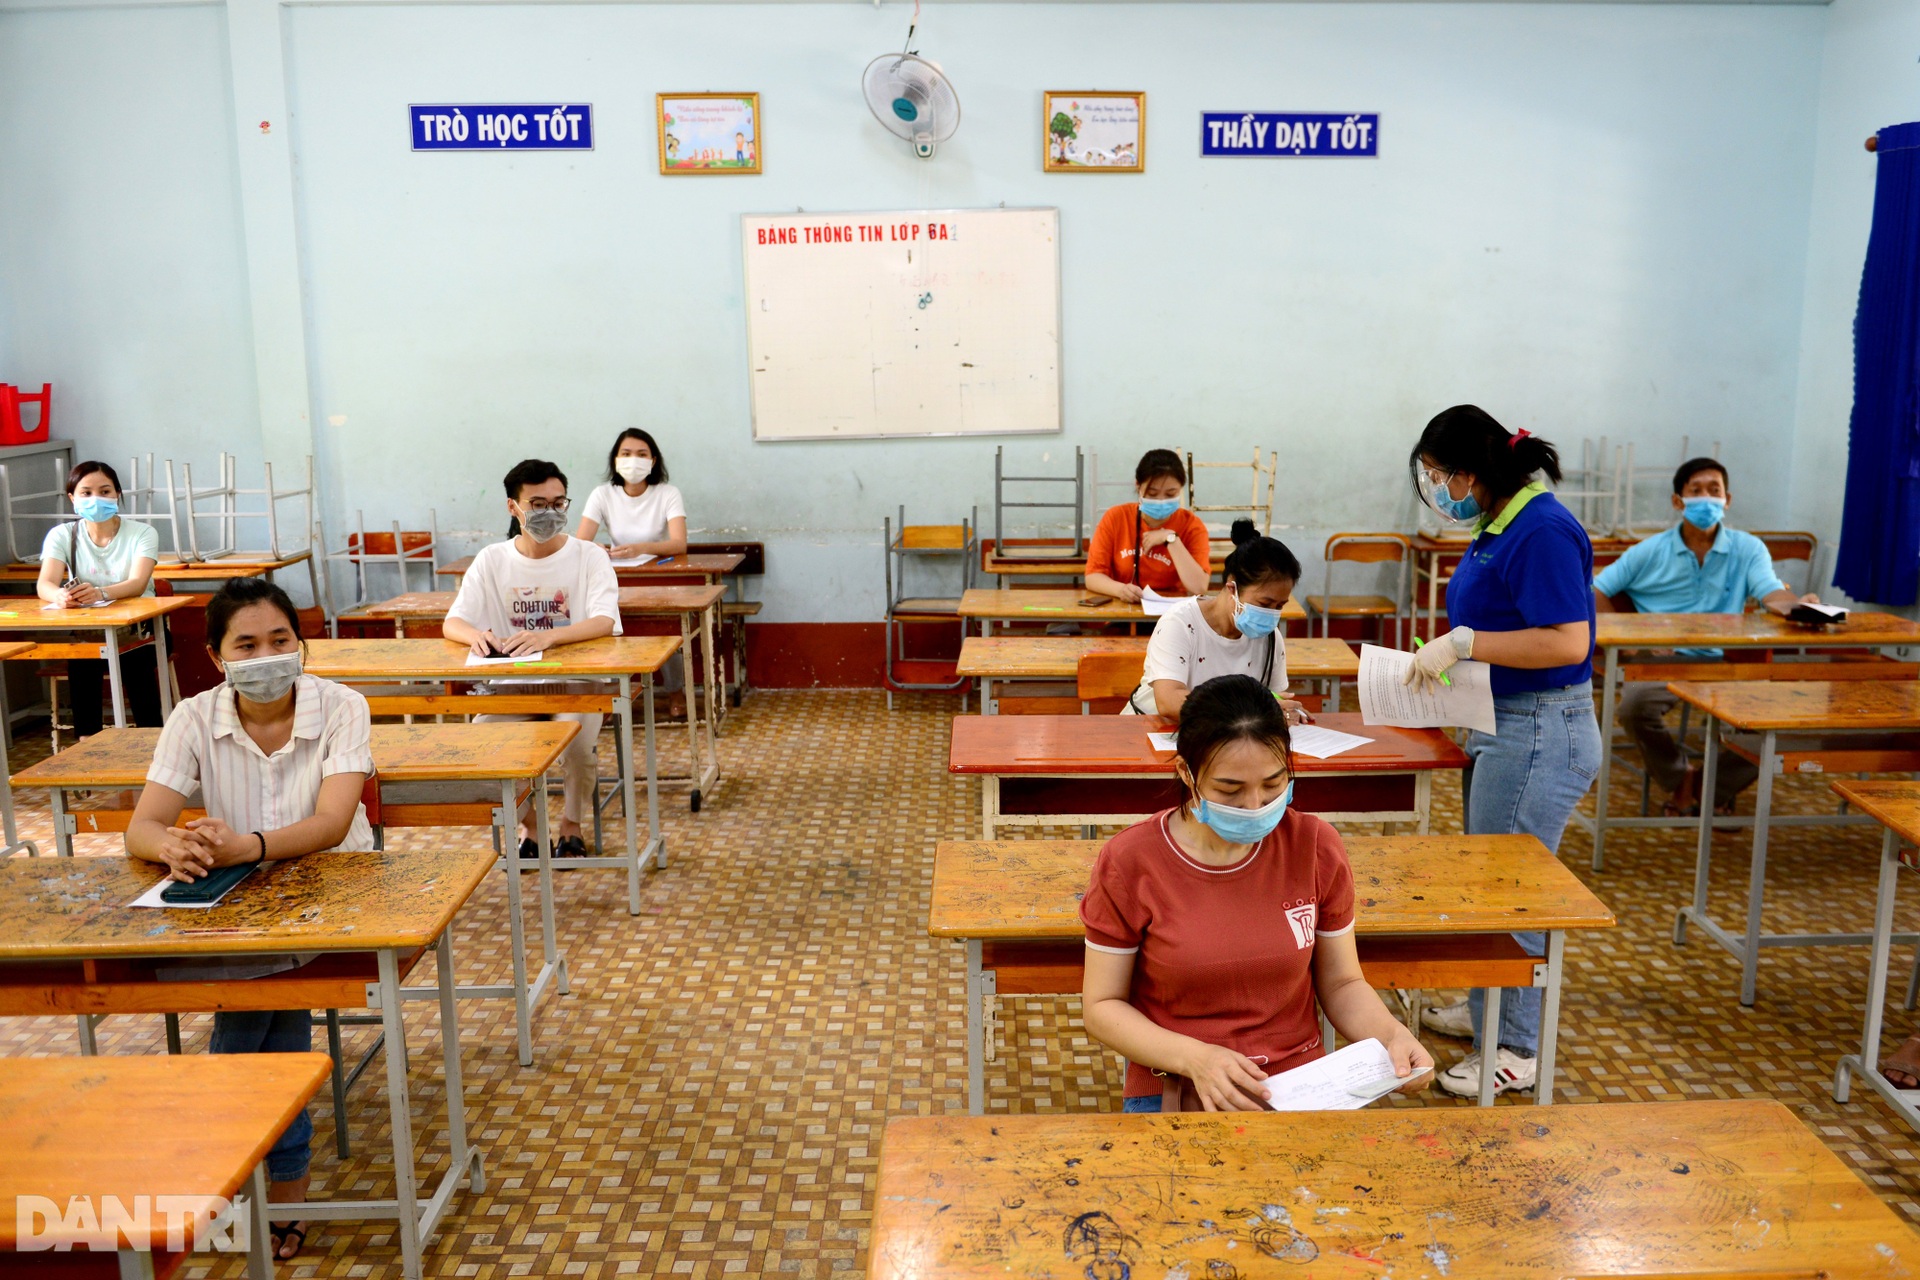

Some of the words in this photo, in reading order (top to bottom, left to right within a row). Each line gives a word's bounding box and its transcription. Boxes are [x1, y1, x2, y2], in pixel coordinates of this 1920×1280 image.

[420, 108, 469, 141] TRÒ
[477, 114, 528, 147] HỌC
[534, 105, 582, 141] TỐT
[1208, 112, 1269, 148] THẦY
[1276, 121, 1321, 154] DẠY
[1328, 114, 1372, 150] TỐT
[804, 222, 853, 244] THÔNG
[858, 225, 884, 243] TIN
[513, 601, 562, 614] COUTURE
[524, 618, 535, 630] IS
